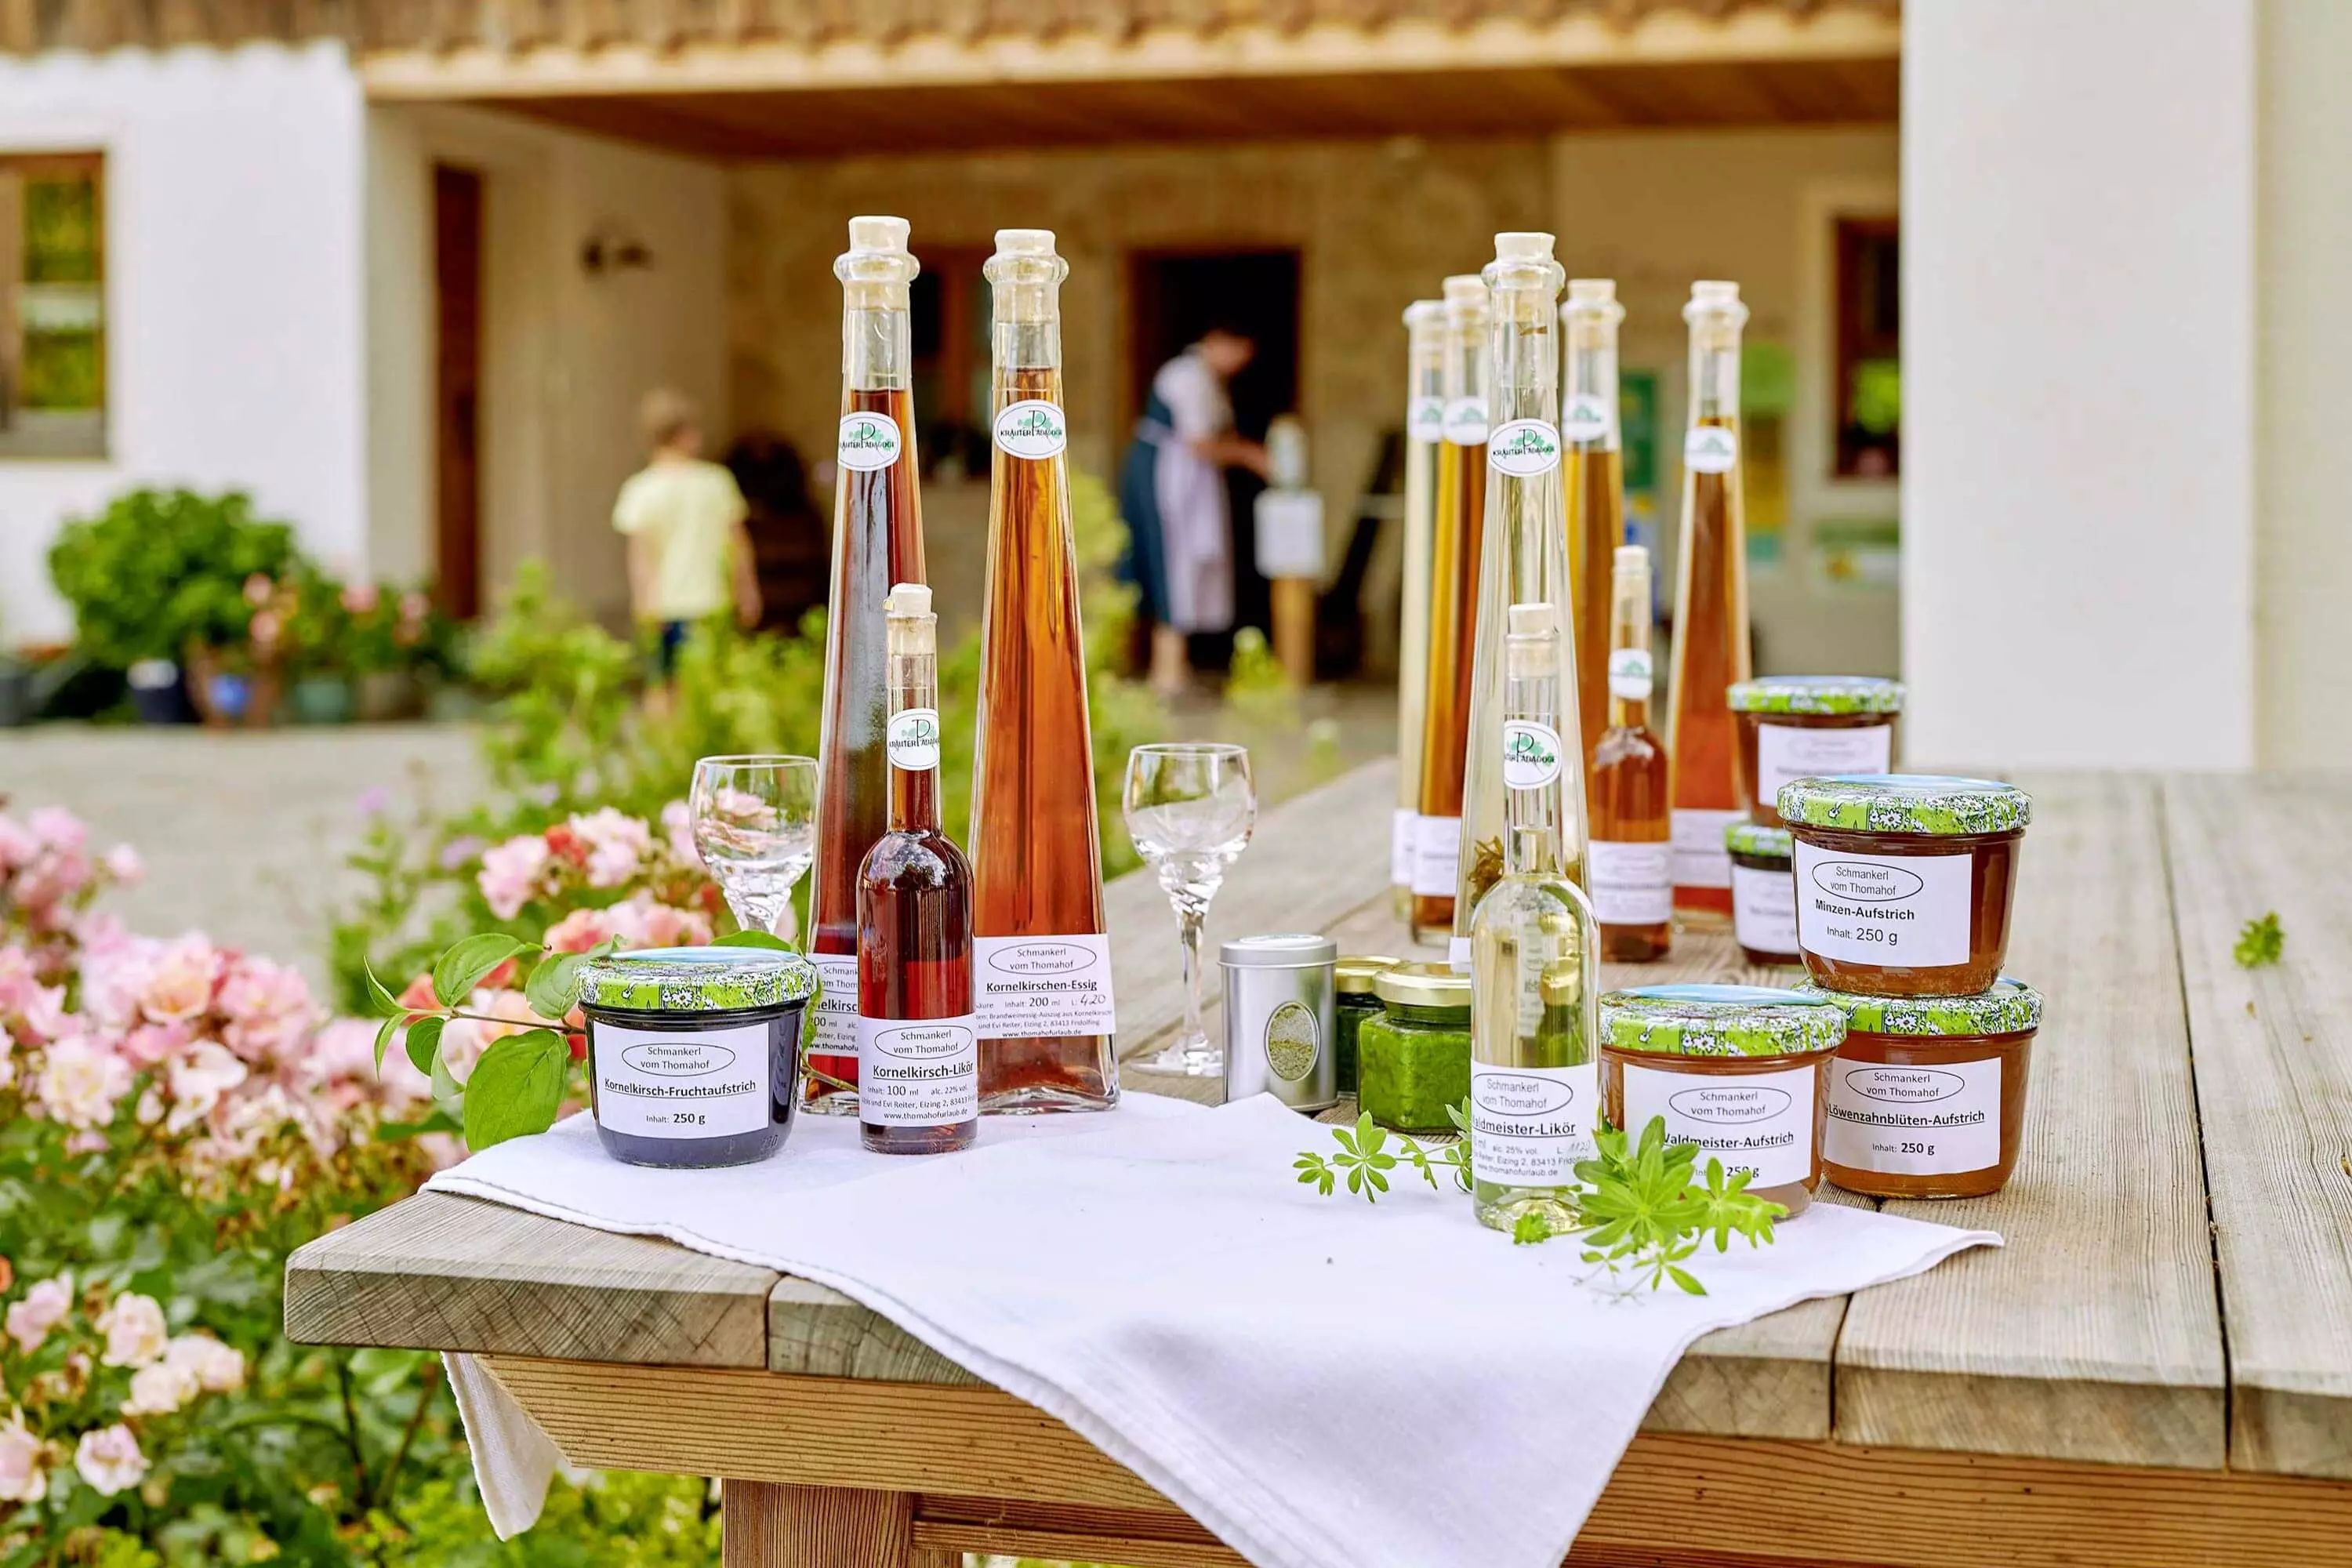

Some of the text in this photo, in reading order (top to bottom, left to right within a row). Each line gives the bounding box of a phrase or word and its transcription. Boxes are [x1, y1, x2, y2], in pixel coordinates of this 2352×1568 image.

[1835, 866, 1889, 880] Schmankerl
[1831, 882, 1896, 895] vom Thomahof
[1816, 898, 1915, 920] Minzen-Aufstrich
[1827, 926, 1897, 946] Inhalt: 250 g
[1017, 948, 1066, 957] Schmankerl
[1031, 960, 1074, 970] Thomahof
[986, 979, 1098, 992] Kornelkirschen-Essig
[818, 999, 857, 1011] elkirsc
[1029, 996, 1049, 1007] 200
[812, 1017, 826, 1026] 00
[901, 1029, 952, 1040] Schmankerl
[648, 1047, 701, 1056] Schmankerl
[916, 1043, 958, 1054] Thomahof
[662, 1060, 710, 1069] Thomahof
[873, 1061, 974, 1078] Kornelkirsch-Likör
[1874, 1073, 1930, 1083] Schmankerl
[604, 1078, 757, 1097] Kornelkirsch-Fruchtaufstrich
[887, 1085, 906, 1096] 100
[945, 1085, 958, 1094] 22%
[1486, 1078, 1539, 1093] Schmankerl
[1700, 1091, 1758, 1102] Schmankerl
[1867, 1087, 1940, 1098] vom Thomahof
[894, 1101, 917, 1109] Reiter,
[1483, 1096, 1548, 1109] vom Thomahof
[884, 1107, 967, 1120] www.thomahofurlaub.de
[1691, 1104, 1766, 1116] vom Thomahof
[1828, 1104, 1984, 1126] Löwenzahnblüten-Aufstrich
[646, 1113, 706, 1125] Inhalt: 250 g
[1506, 1145, 1523, 1154] 25%
[1872, 1143, 1935, 1156] Inhalt: 250 g
[1531, 1157, 1556, 1167] 83413
[1752, 1167, 1759, 1178] g
